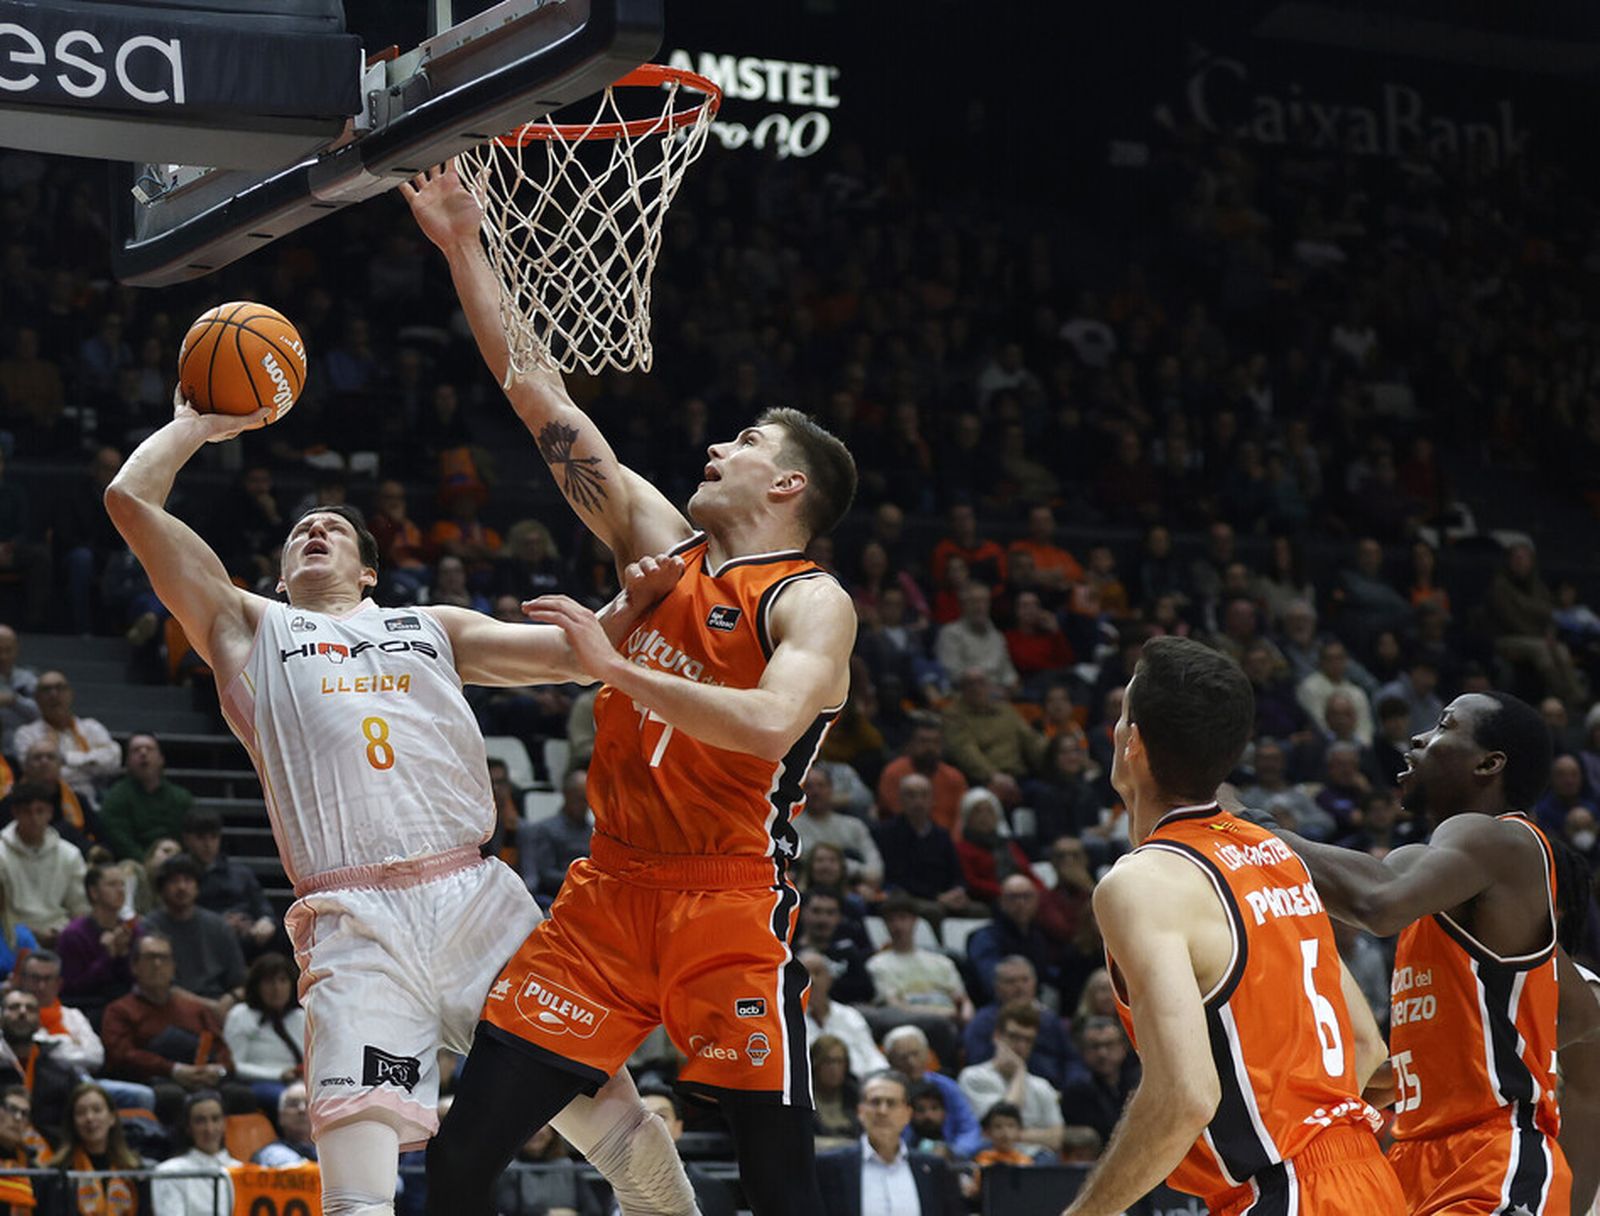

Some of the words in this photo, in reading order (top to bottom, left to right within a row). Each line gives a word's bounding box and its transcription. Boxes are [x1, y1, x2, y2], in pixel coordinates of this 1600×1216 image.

[1186, 56, 1531, 170] CaixaBank
[321, 674, 411, 694] LLEIDA
[362, 716, 395, 770] 8
[524, 981, 596, 1026] PULEVA
[739, 1005, 760, 1016] acb
[1300, 938, 1344, 1077] 6
